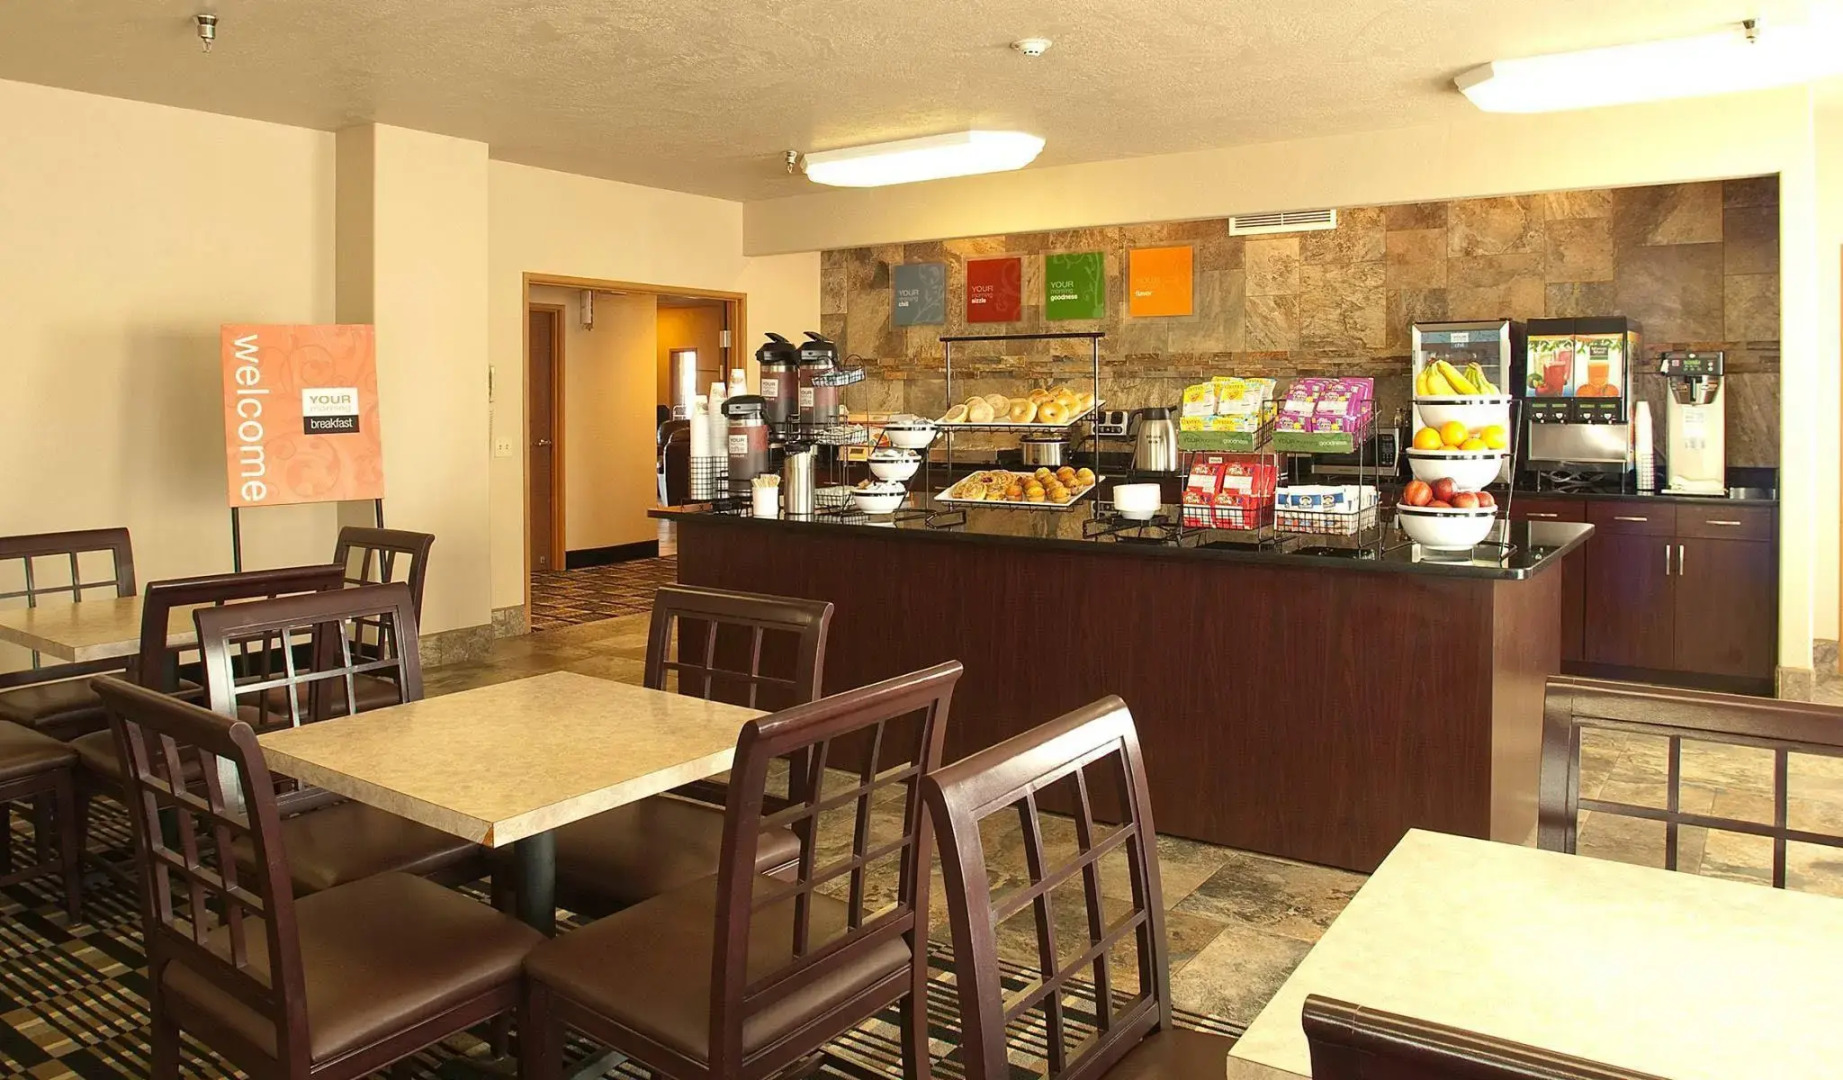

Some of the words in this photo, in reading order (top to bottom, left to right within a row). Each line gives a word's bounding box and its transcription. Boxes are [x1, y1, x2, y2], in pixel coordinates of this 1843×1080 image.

[1051, 280, 1074, 288] YOUR
[972, 285, 994, 293] YOUR
[1050, 293, 1078, 302] goodness
[309, 395, 352, 404] YOUR
[233, 334, 270, 502] welcome
[310, 418, 353, 429] breakfast
